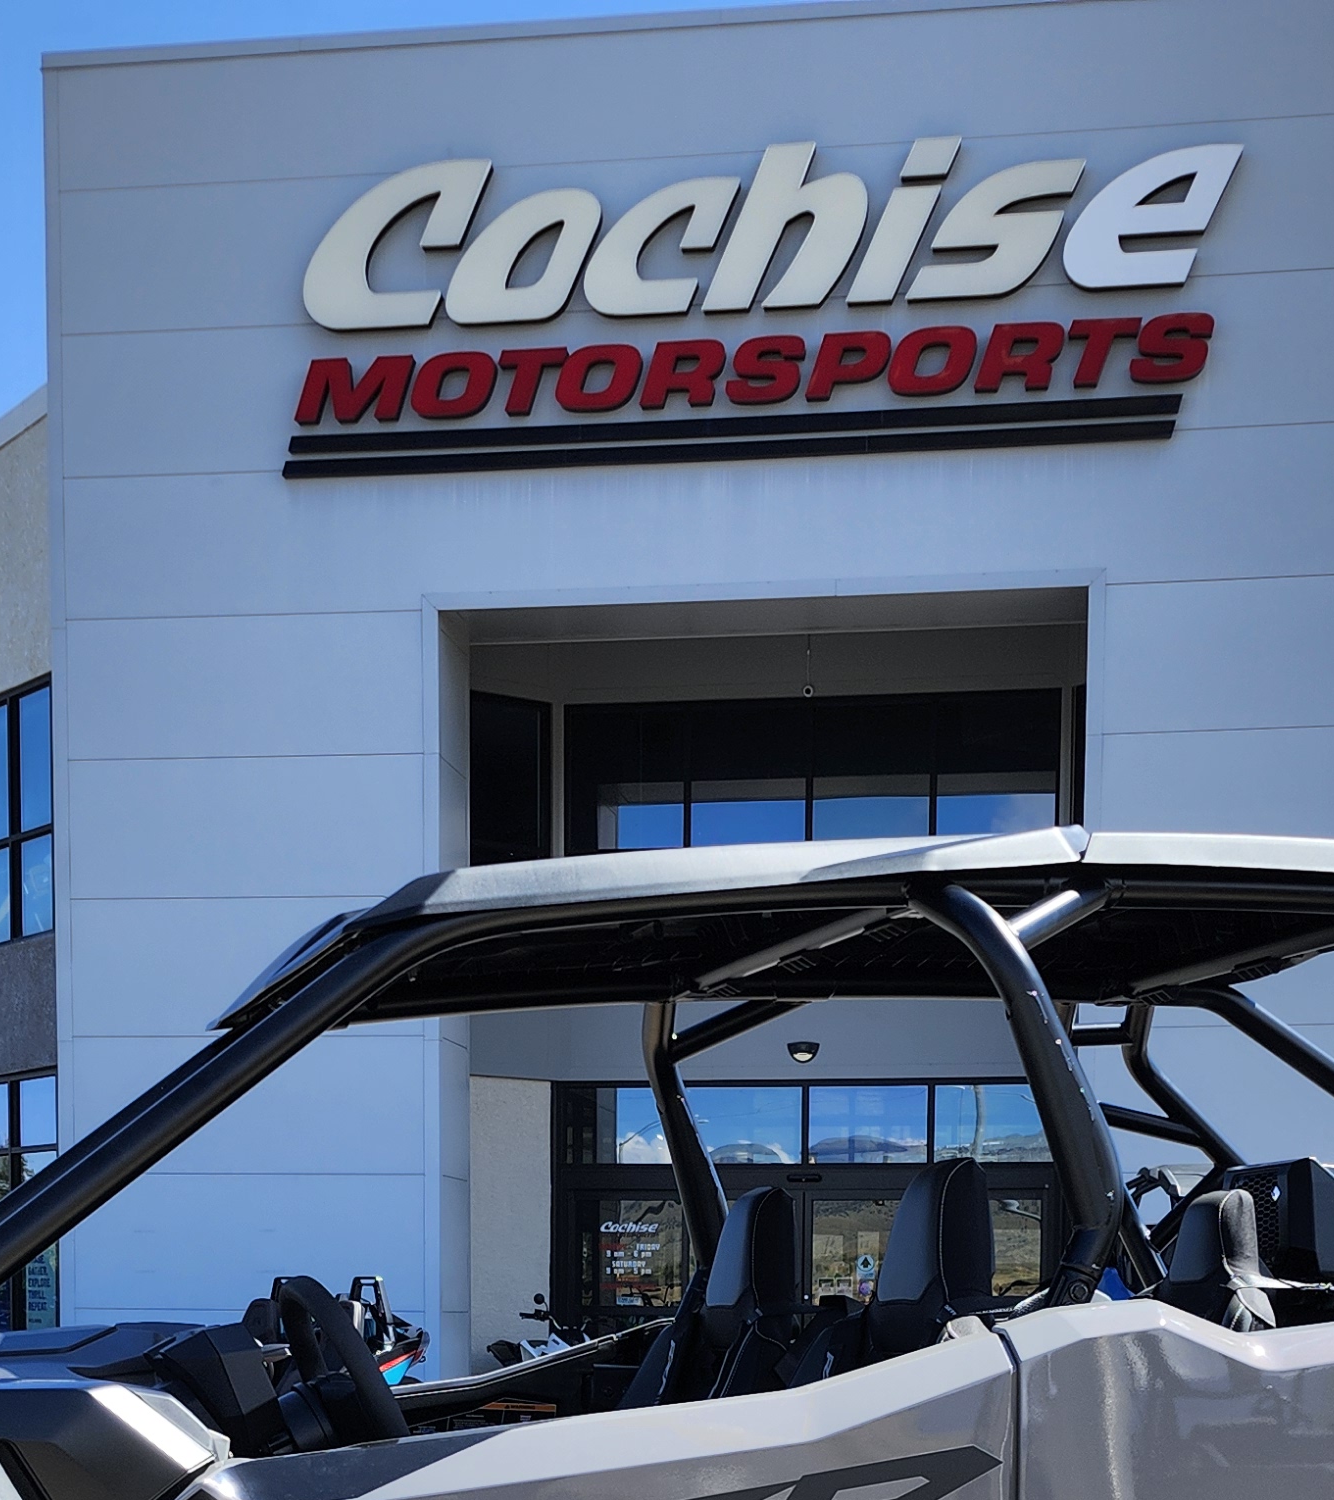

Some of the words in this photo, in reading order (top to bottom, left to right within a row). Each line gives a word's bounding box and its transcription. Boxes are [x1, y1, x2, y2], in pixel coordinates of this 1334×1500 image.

[303, 135, 1244, 331] Cochise
[294, 311, 1216, 427] MOTORSPORTS
[600, 1220, 659, 1233] Cochise
